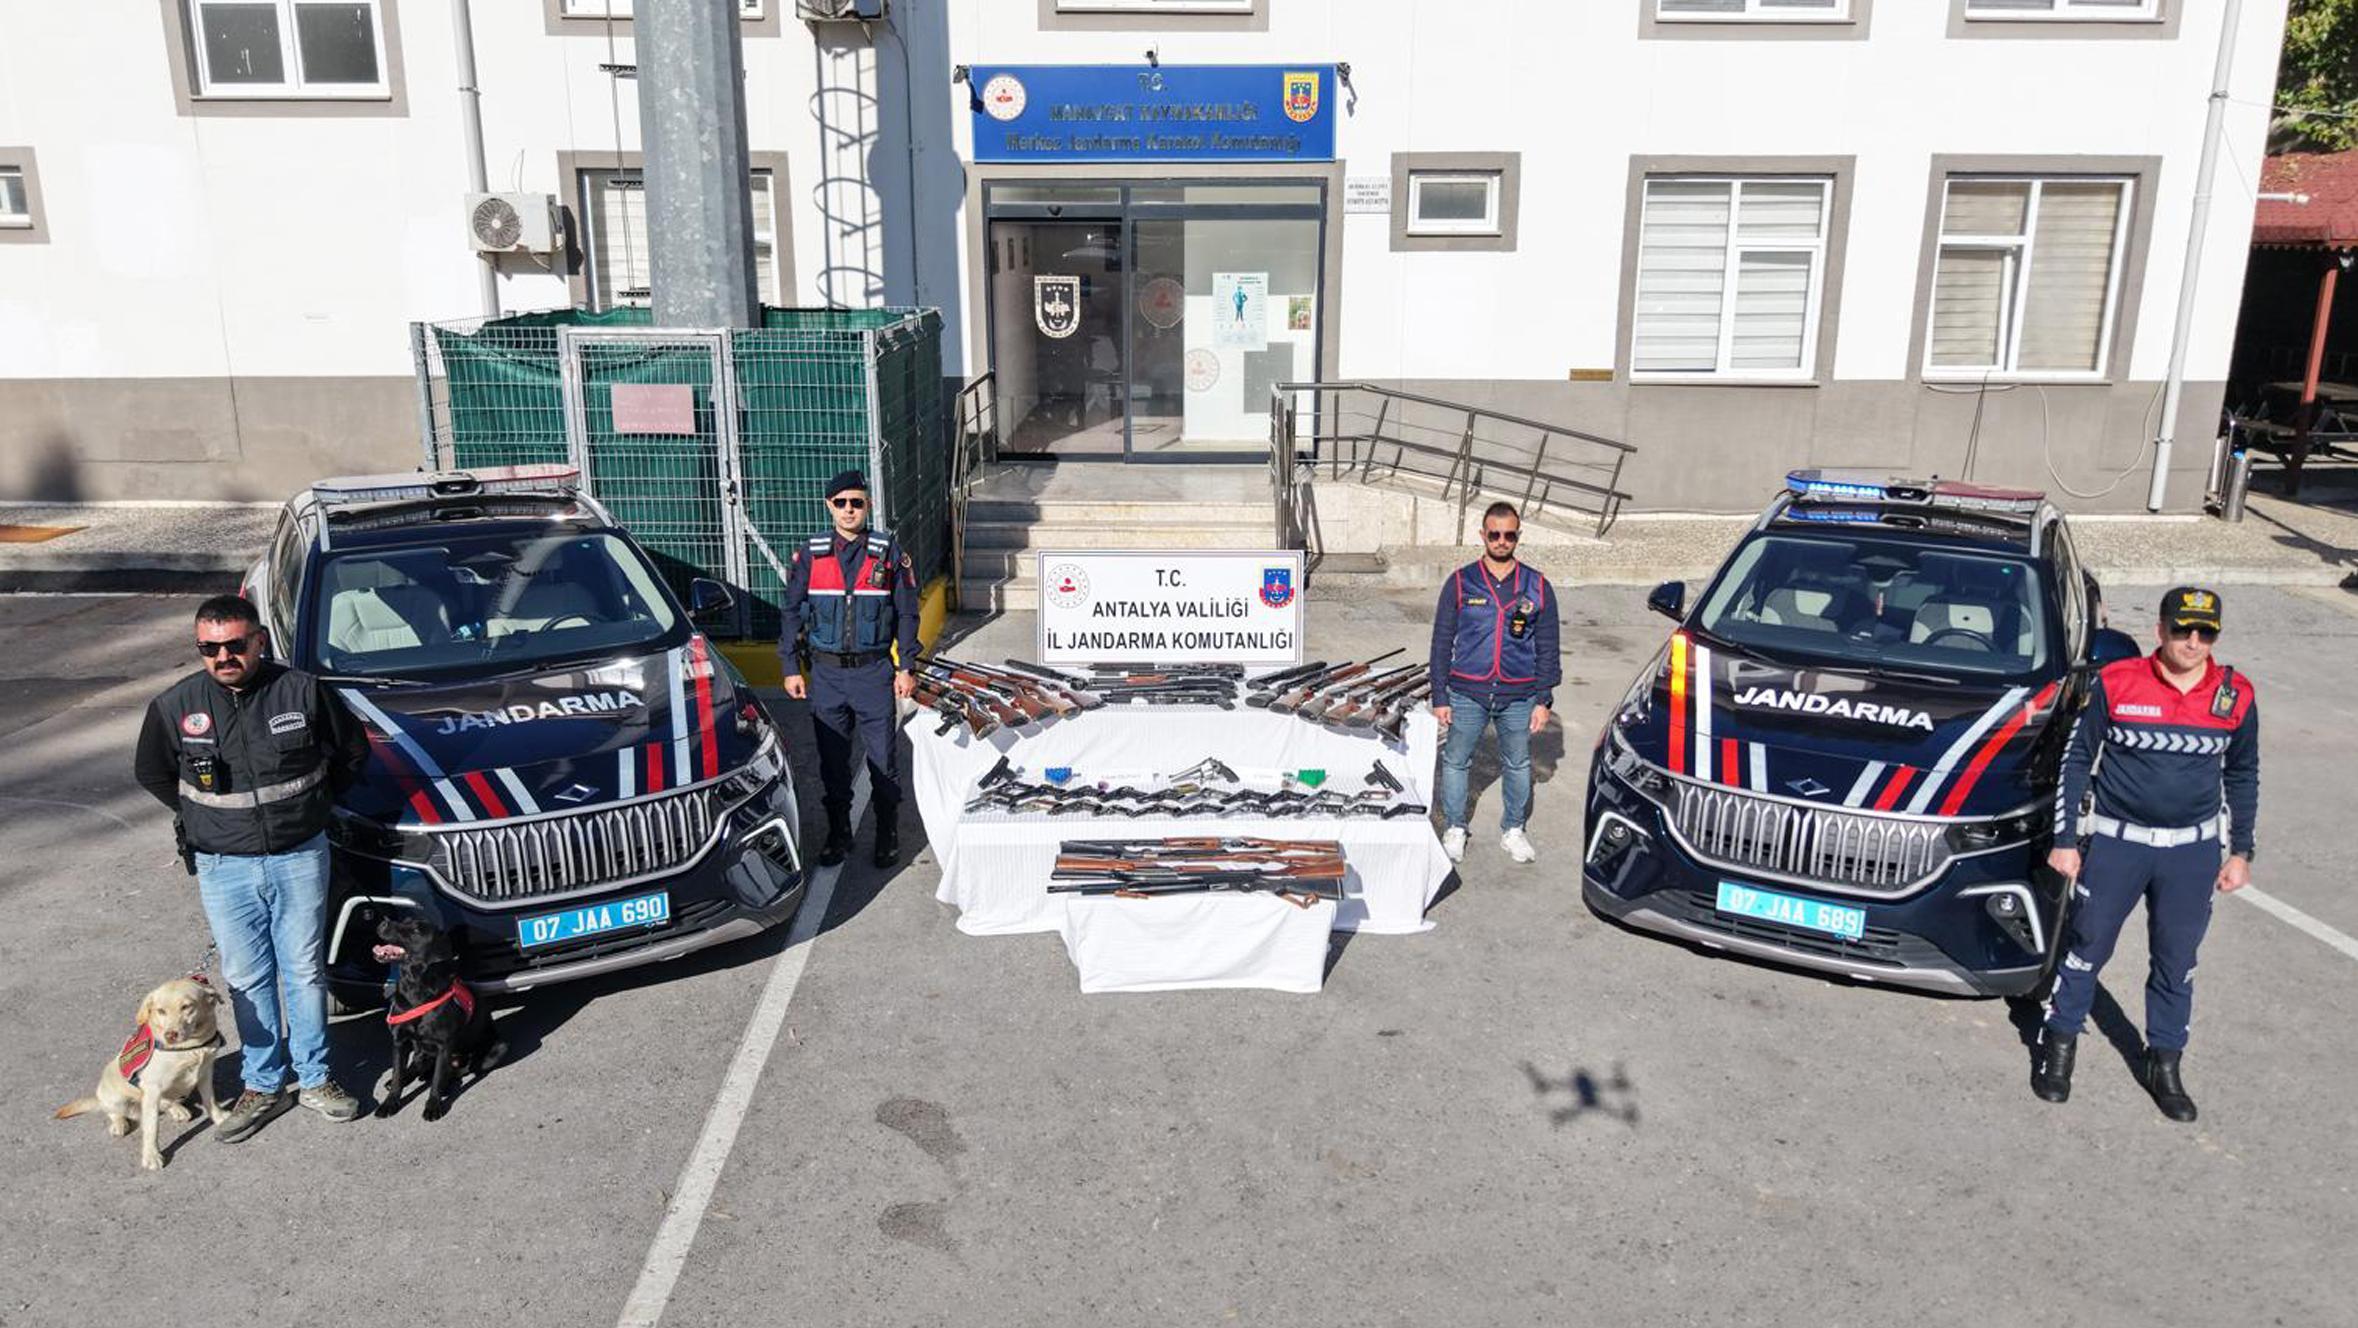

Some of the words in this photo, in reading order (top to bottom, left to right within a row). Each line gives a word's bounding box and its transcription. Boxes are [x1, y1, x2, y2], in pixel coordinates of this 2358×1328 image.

[1155, 569, 1186, 587] T.C.
[1092, 601, 1171, 617] ANTALYA
[1176, 598, 1249, 617] VALİLİĞİ
[1047, 627, 1062, 649] İL
[1068, 632, 1167, 649] JANDARMA
[1173, 628, 1293, 649] KOMUTANLIĞI
[437, 690, 645, 736] JANDARMA
[1733, 687, 1934, 731] JANDARMA
[534, 916, 560, 941] 07
[572, 907, 612, 933] JAA
[622, 897, 662, 923] 690
[1731, 888, 1758, 912] 07
[1767, 896, 1805, 924] JAA
[1818, 906, 1859, 933] 689
